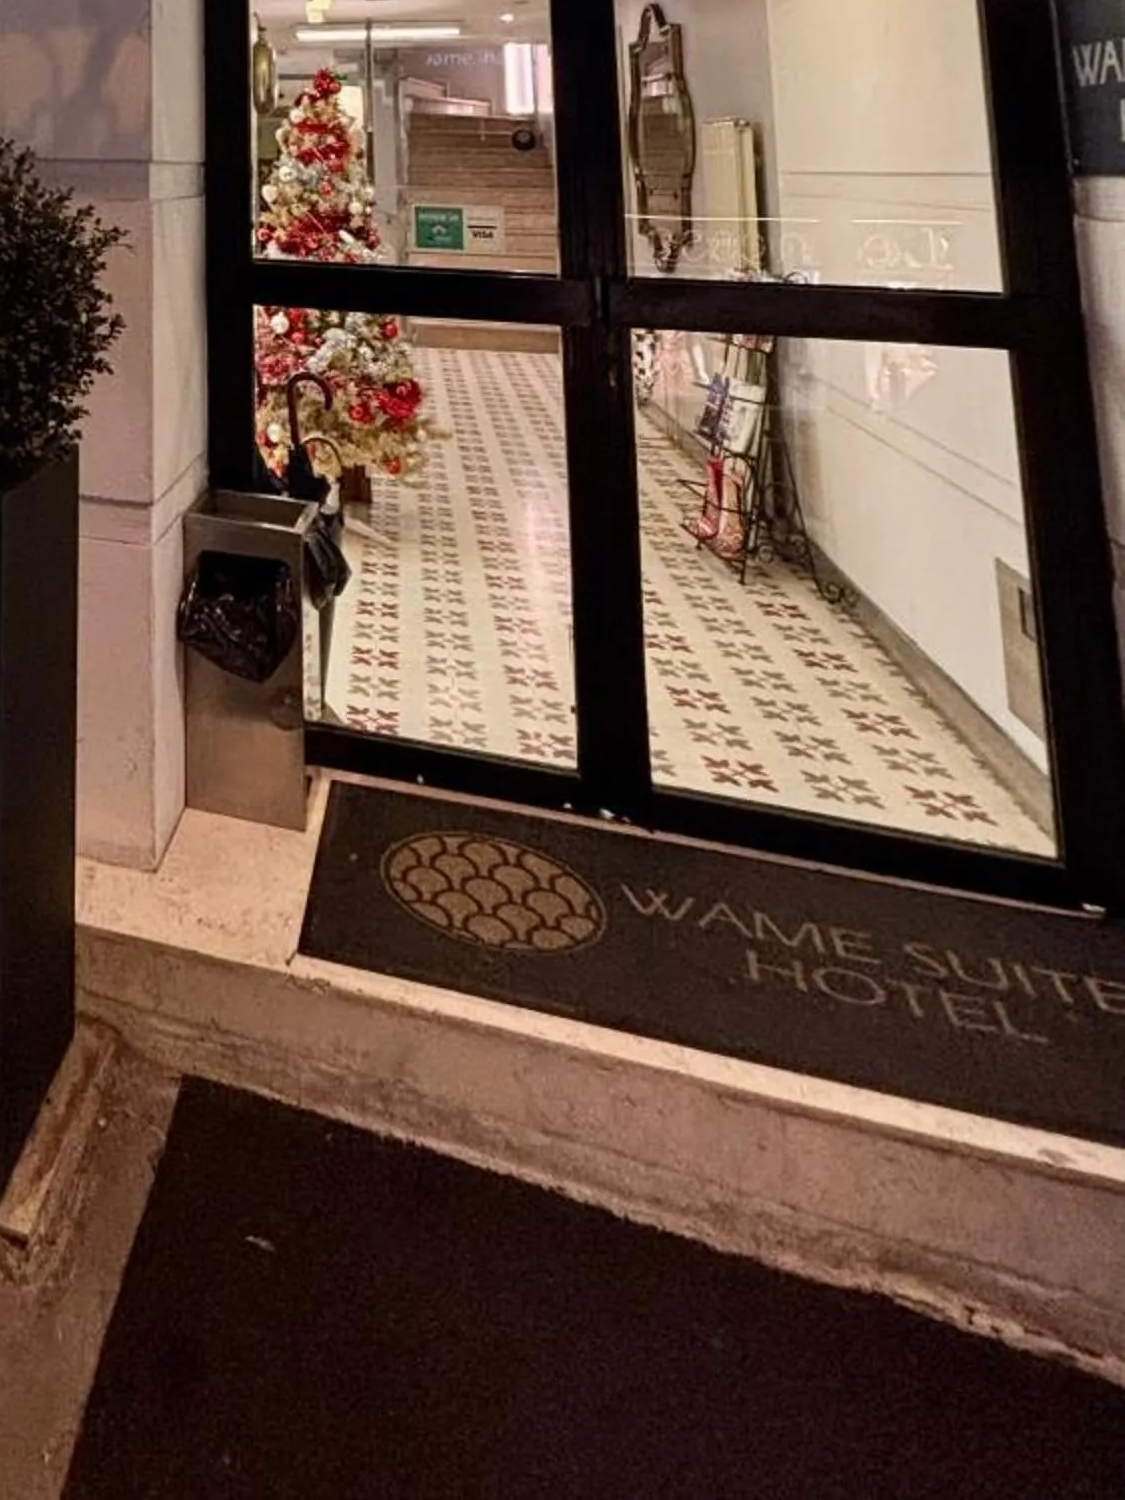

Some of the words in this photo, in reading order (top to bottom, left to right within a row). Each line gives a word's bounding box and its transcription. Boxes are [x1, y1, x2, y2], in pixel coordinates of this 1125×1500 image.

[1072, 38, 1125, 88] WA
[621, 883, 883, 966] WAME
[903, 941, 1125, 1016] SUITE
[745, 948, 1050, 1043] HOTEL
